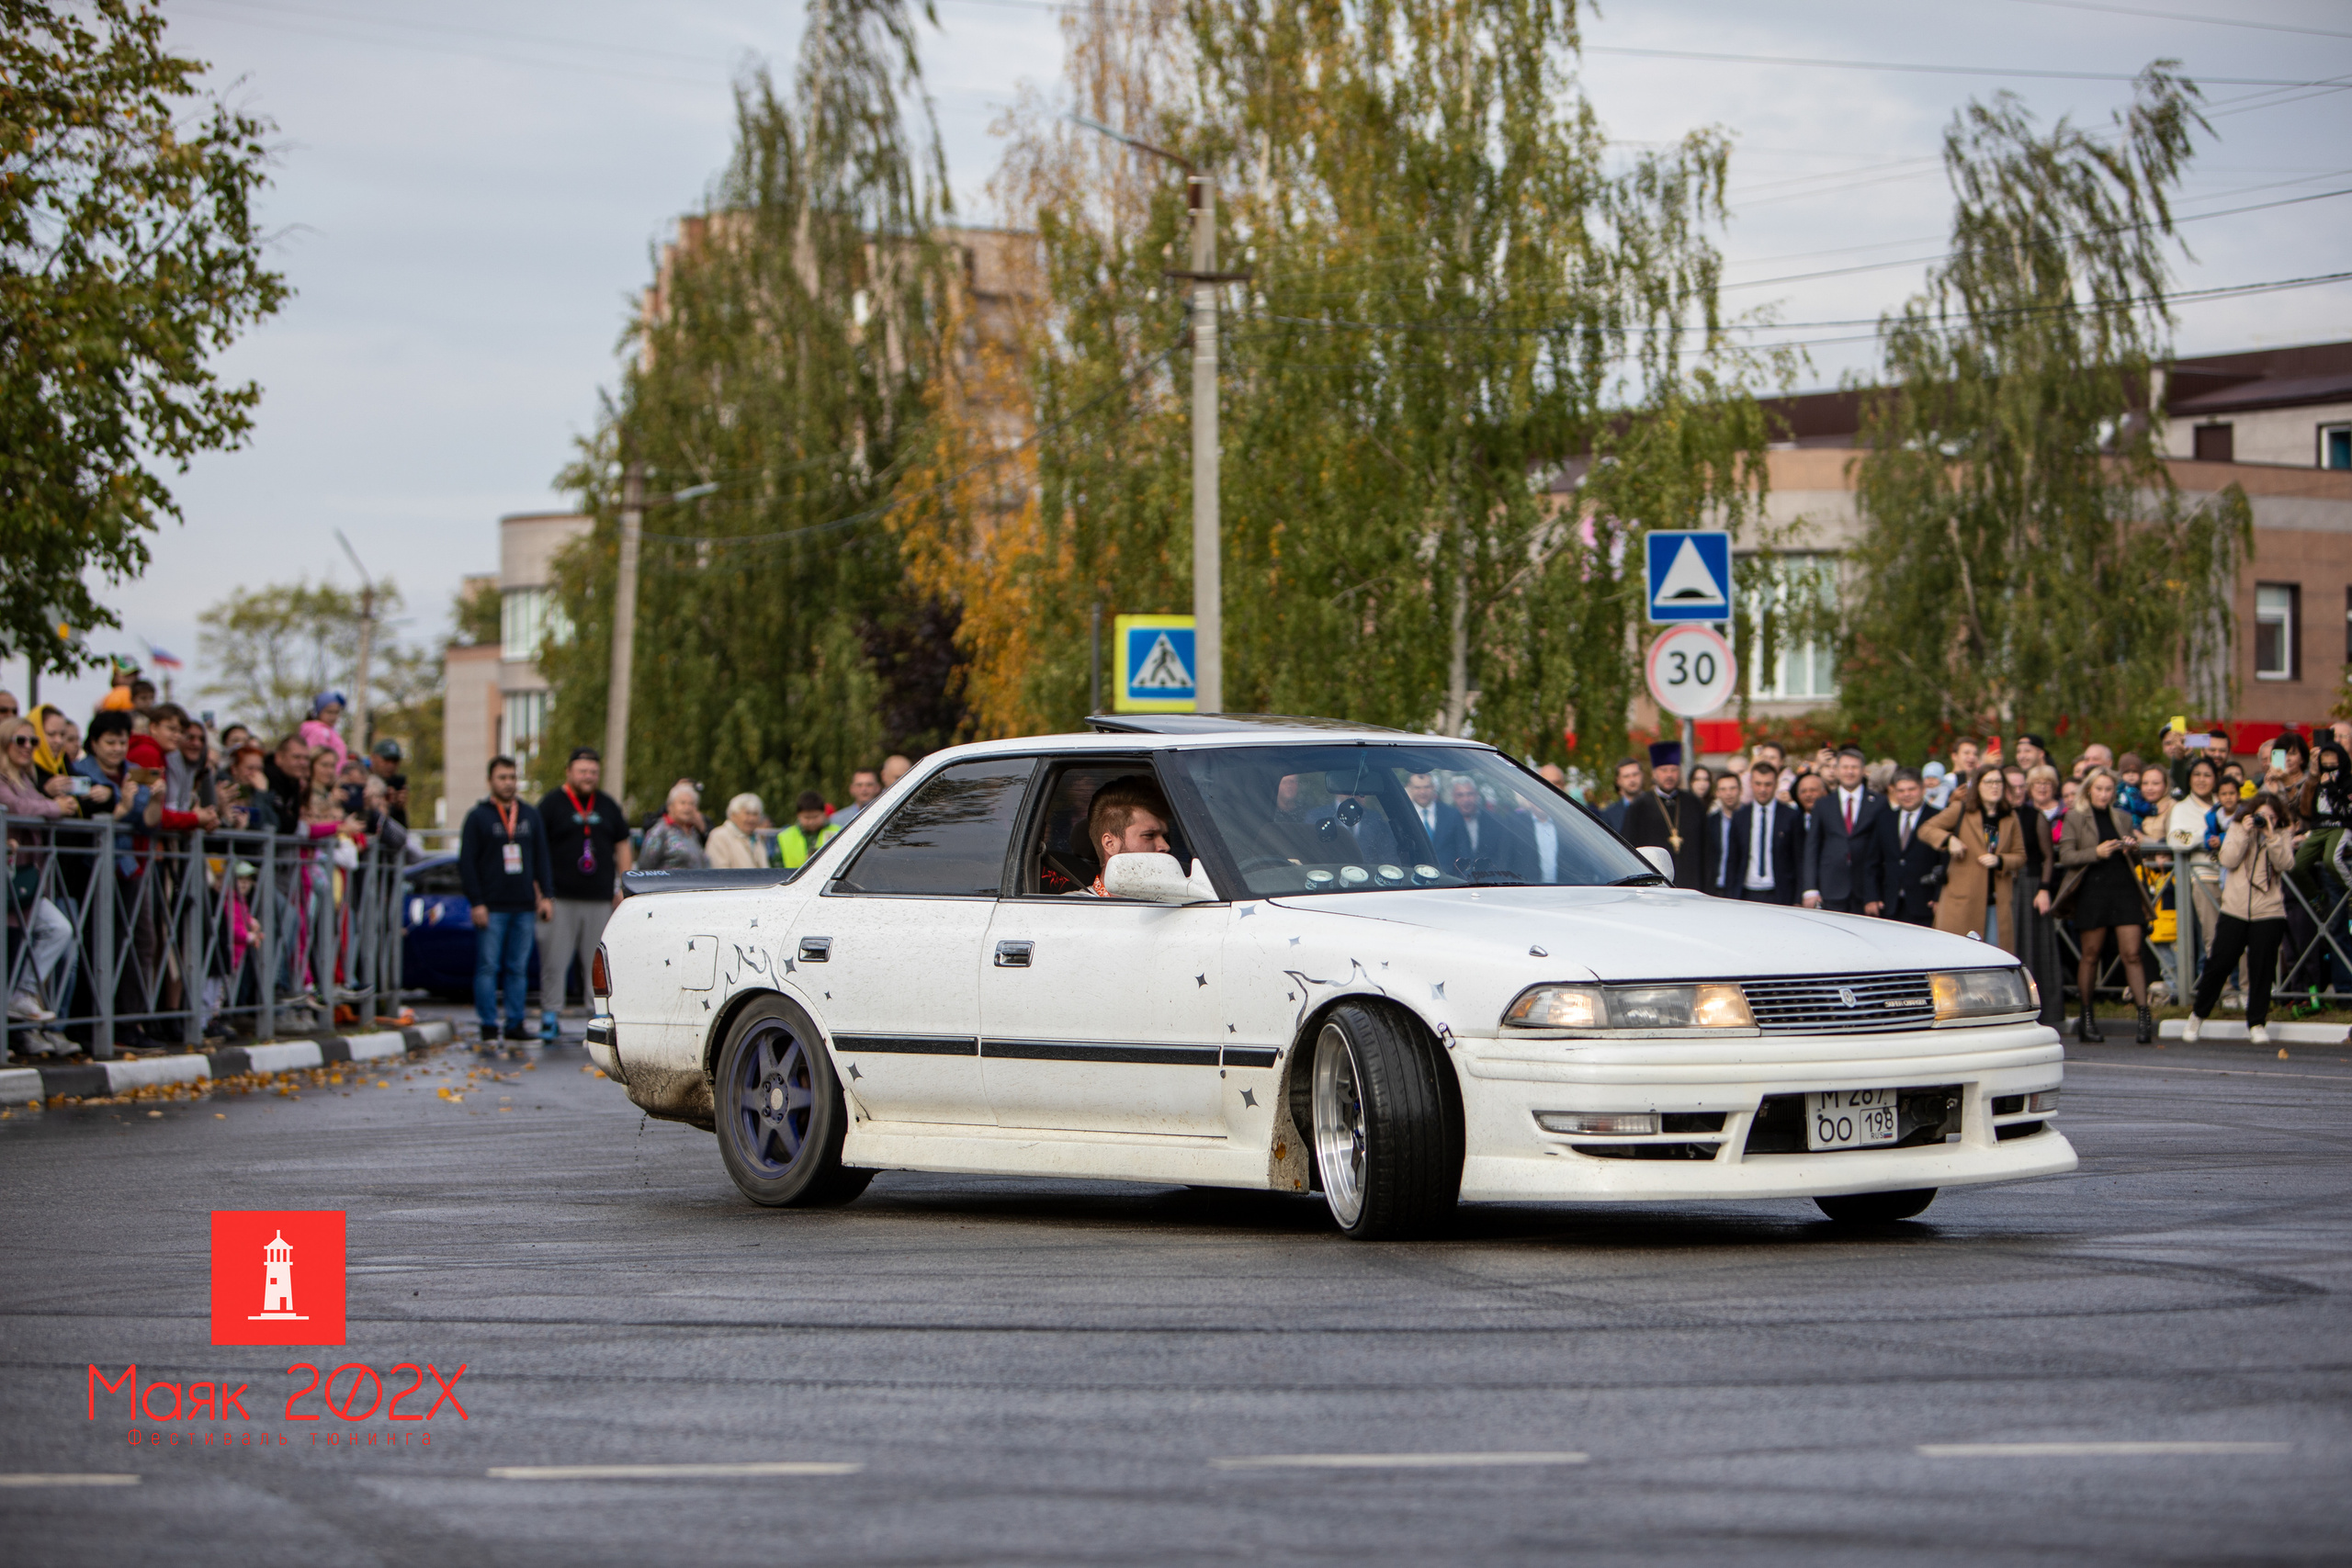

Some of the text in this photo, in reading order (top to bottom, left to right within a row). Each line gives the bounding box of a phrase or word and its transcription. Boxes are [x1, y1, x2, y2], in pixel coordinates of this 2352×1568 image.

[1668, 651, 1715, 685] 30
[1865, 1111, 1894, 1133] 198
[1871, 1132, 1883, 1140] RUS
